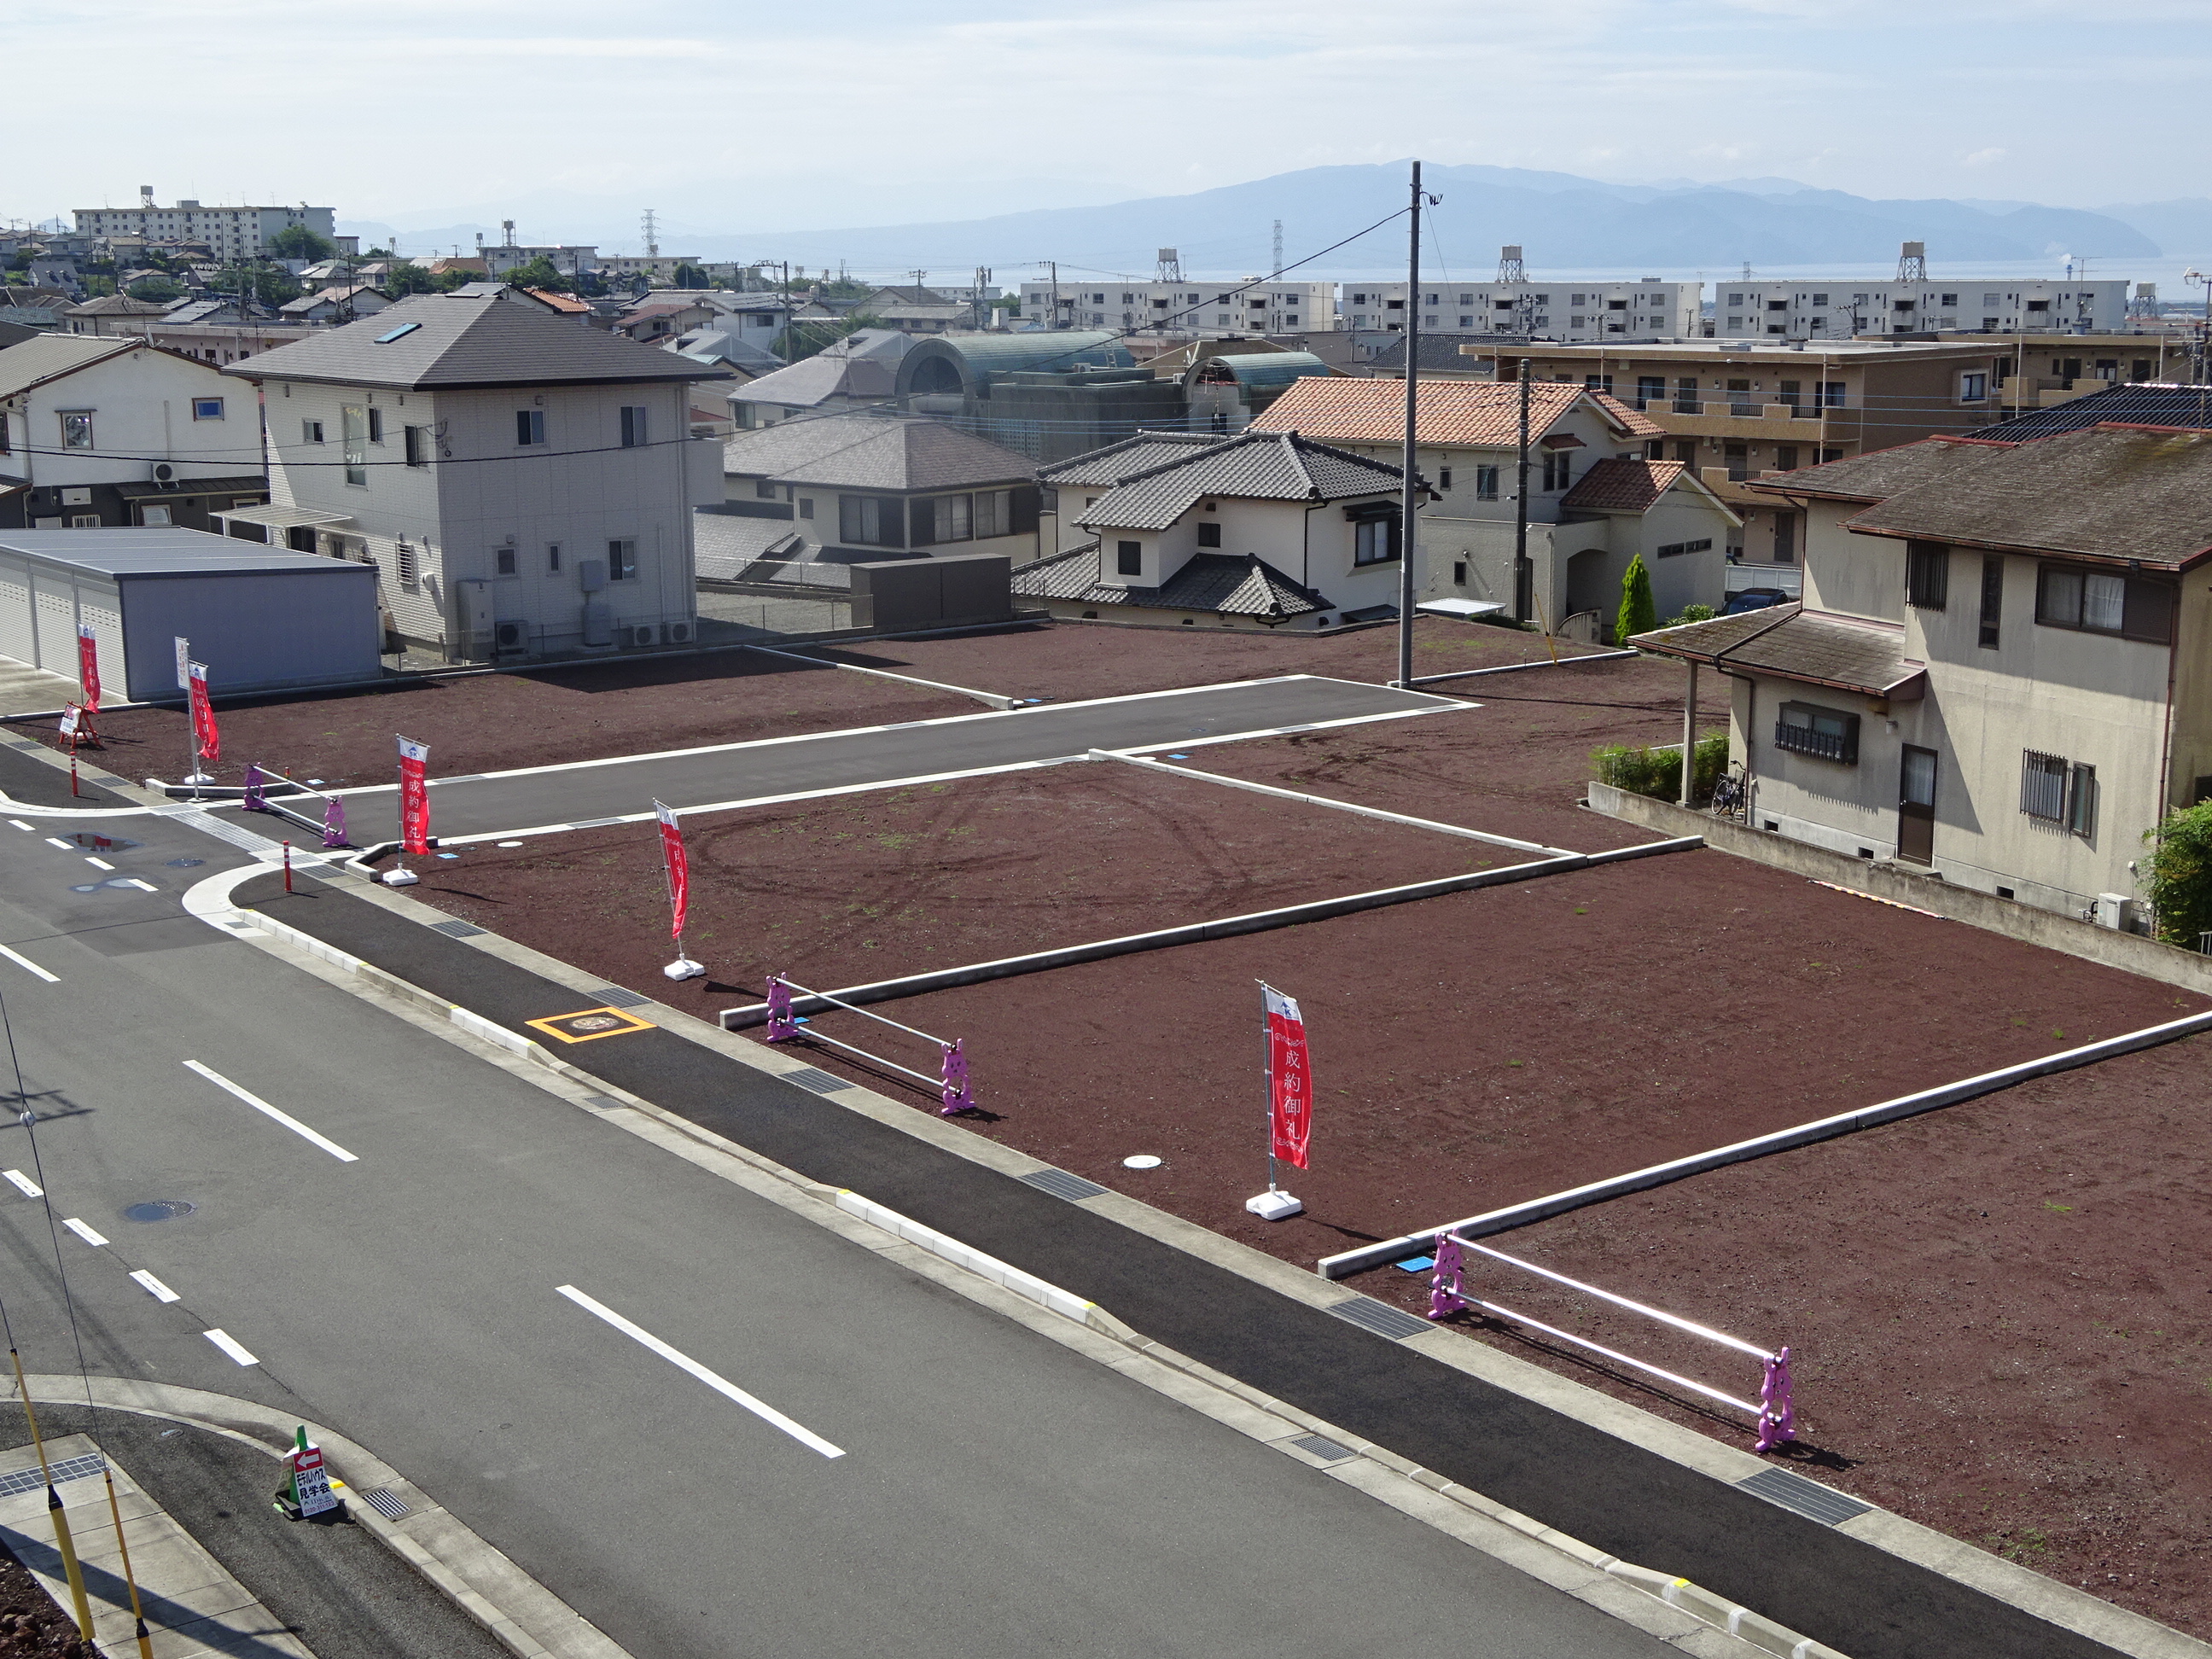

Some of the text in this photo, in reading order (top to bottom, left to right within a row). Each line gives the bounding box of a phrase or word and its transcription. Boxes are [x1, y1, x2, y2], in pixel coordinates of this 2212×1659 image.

[407, 779, 421, 839] 成約御礼
[1284, 1050, 1301, 1140] 成約御礼
[296, 1468, 326, 1487] モデルハウス
[300, 1481, 330, 1500] 見学会
